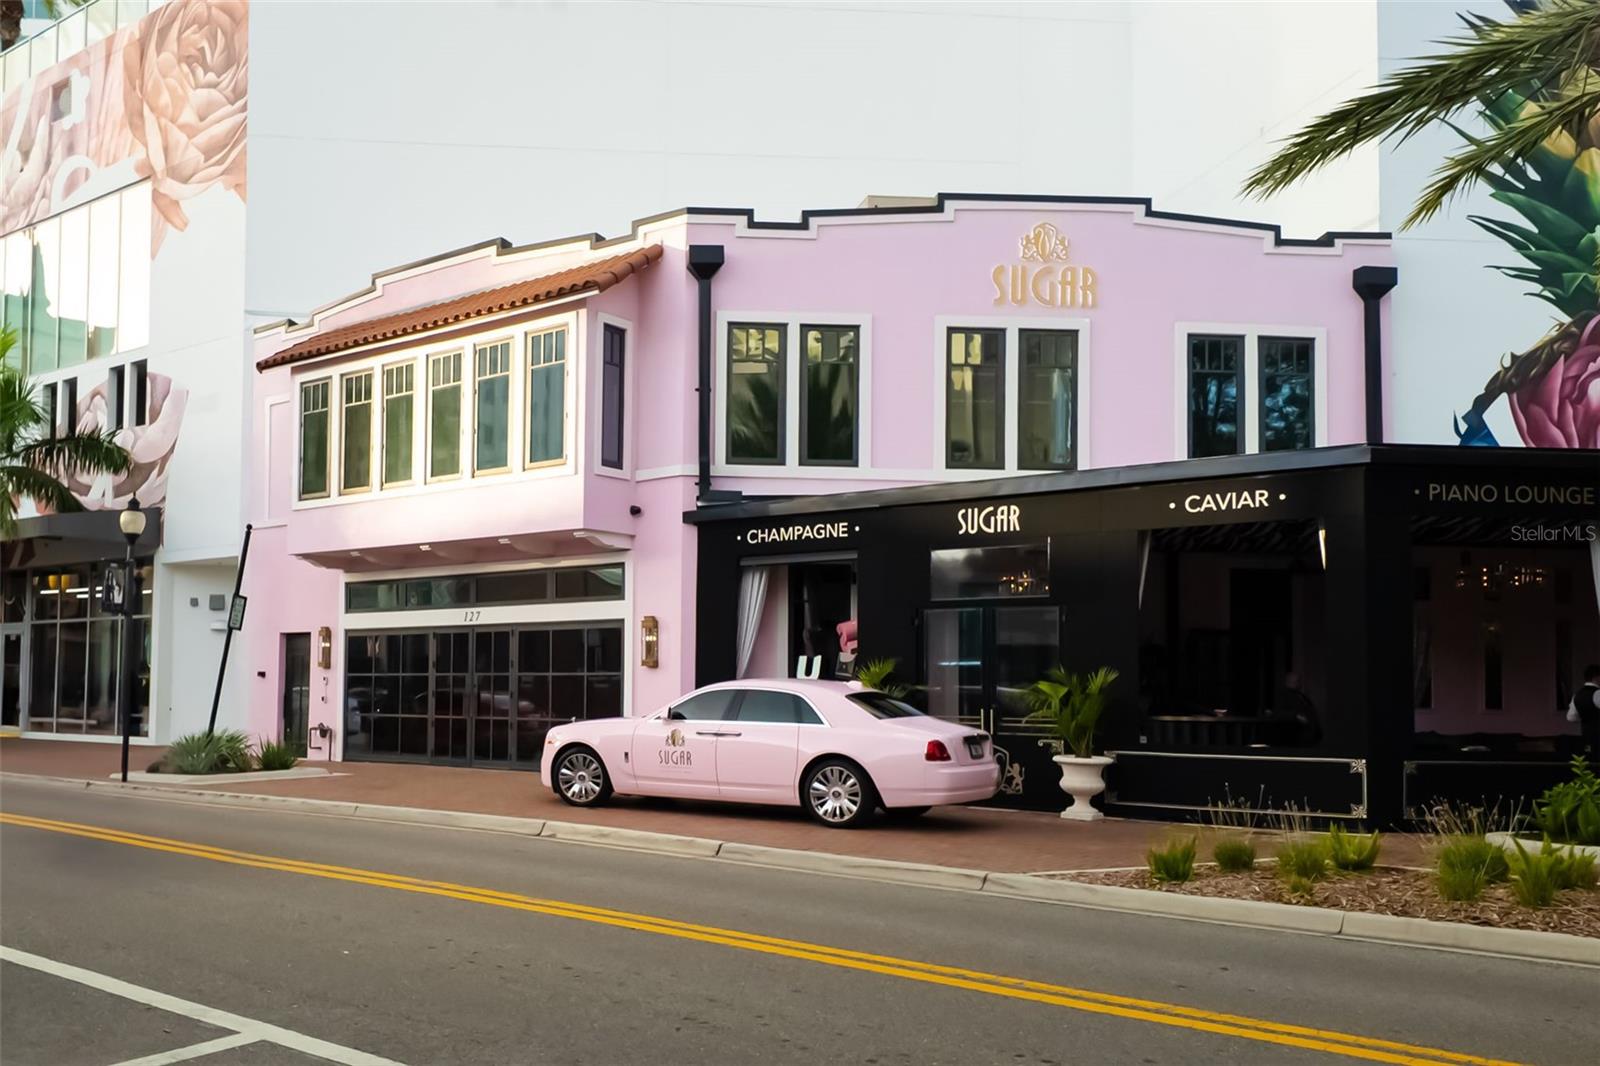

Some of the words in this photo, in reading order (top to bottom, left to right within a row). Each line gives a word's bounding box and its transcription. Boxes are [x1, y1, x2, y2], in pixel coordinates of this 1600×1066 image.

[990, 262, 1099, 308] SUGAR
[1185, 489, 1269, 513] CAVIAR
[1428, 483, 1498, 503] PIANO
[1504, 485, 1595, 505] LOUNGE
[957, 504, 1020, 536] SUGAR
[746, 522, 849, 544] CHAMPAGNE
[464, 610, 481, 622] 127
[658, 750, 692, 766] SUGAR
